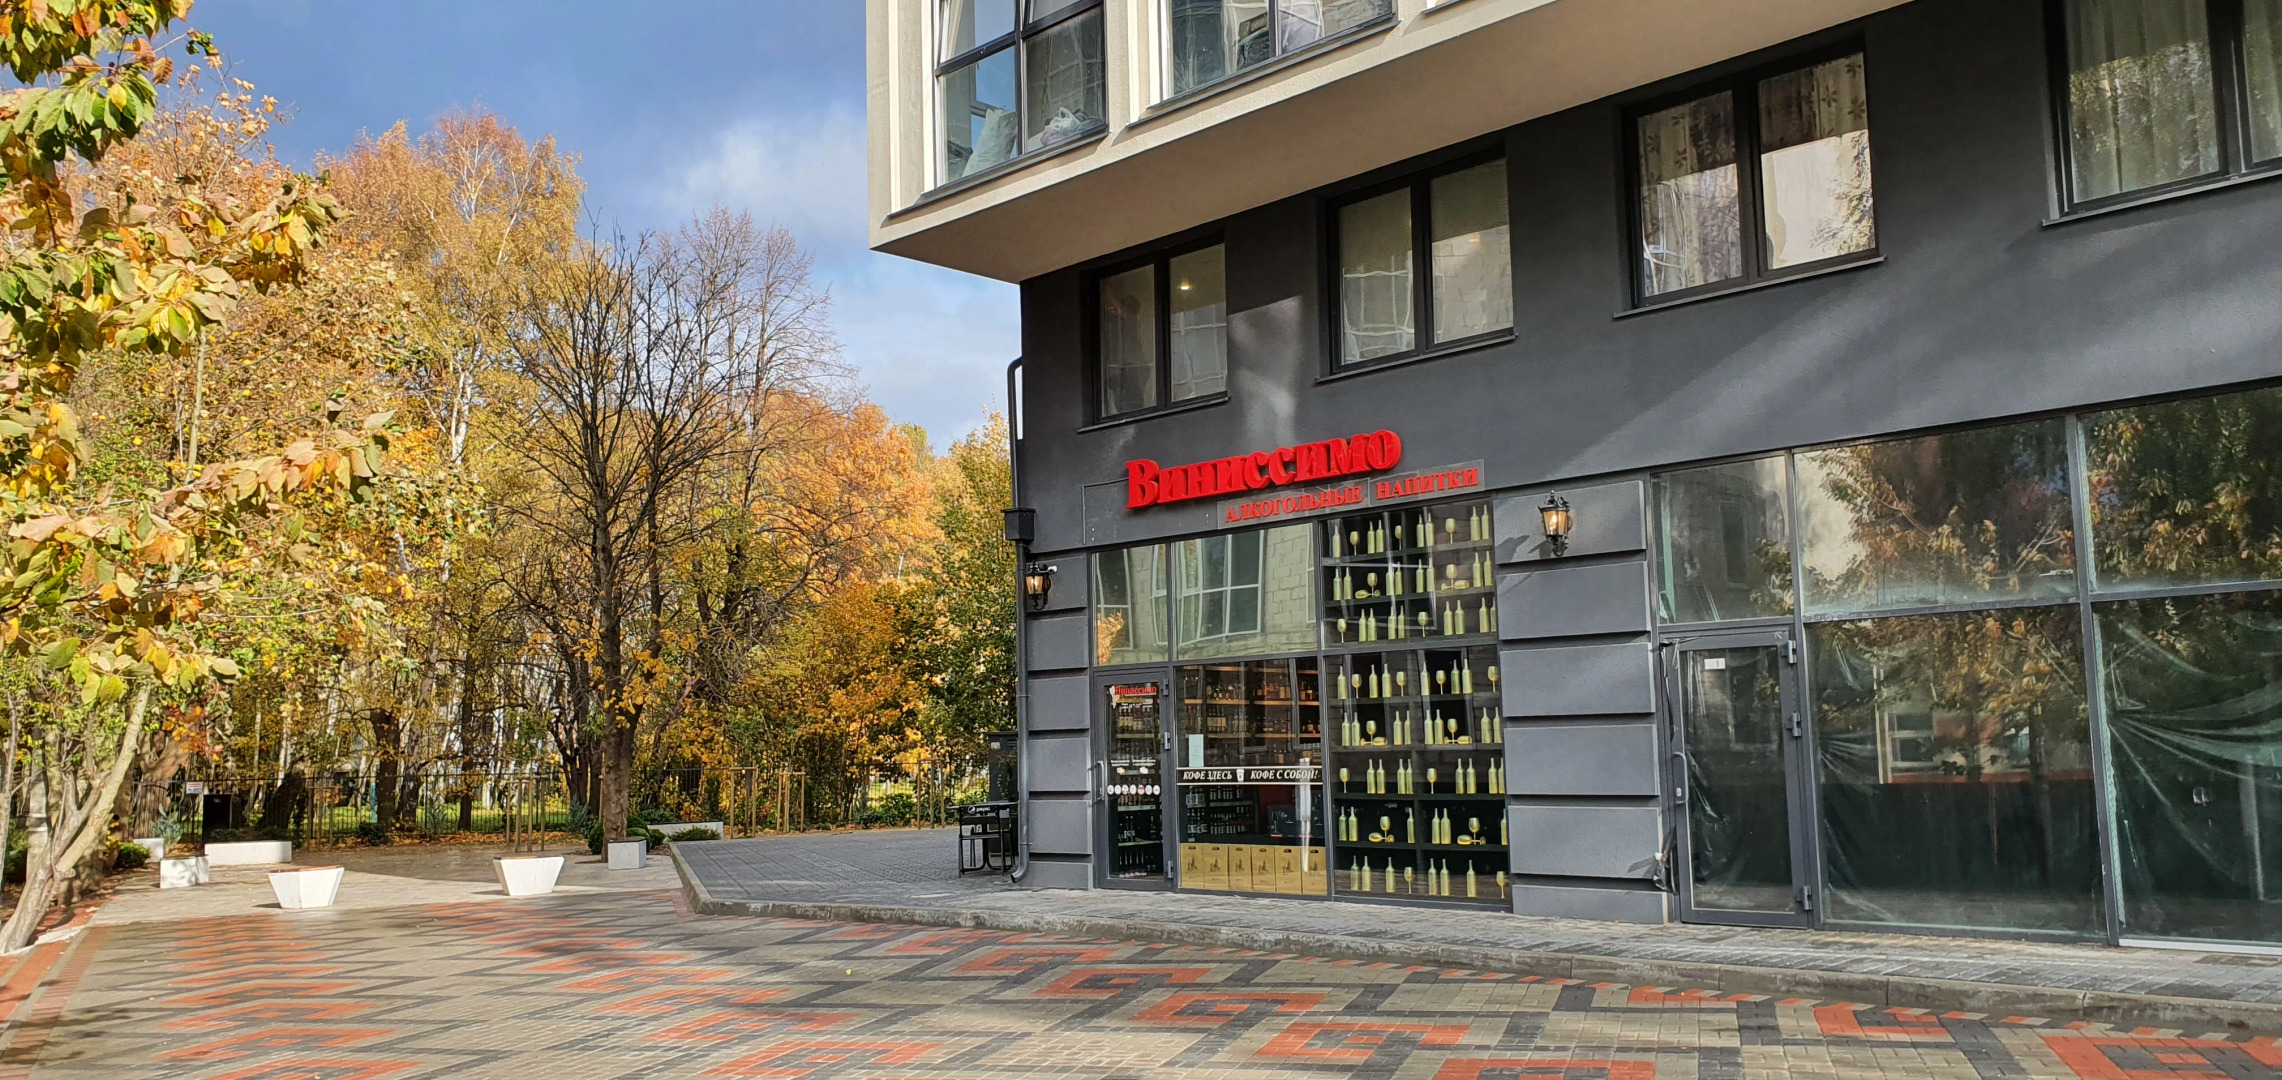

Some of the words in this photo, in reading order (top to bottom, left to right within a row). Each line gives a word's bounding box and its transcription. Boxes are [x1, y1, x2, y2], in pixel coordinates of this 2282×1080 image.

[1125, 430, 1402, 509] Виниссимо
[1225, 486, 1364, 523] АЛКОГОЛЬНЫЕ
[1376, 468, 1478, 500] НАПИТКИ
[1183, 771, 1206, 780] КОФЕ
[1206, 771, 1233, 781] ЗДЕСЬ
[1250, 770, 1275, 780] КОФЕ
[1276, 770, 1283, 779] С
[1284, 768, 1319, 780] СОБОЙ!
